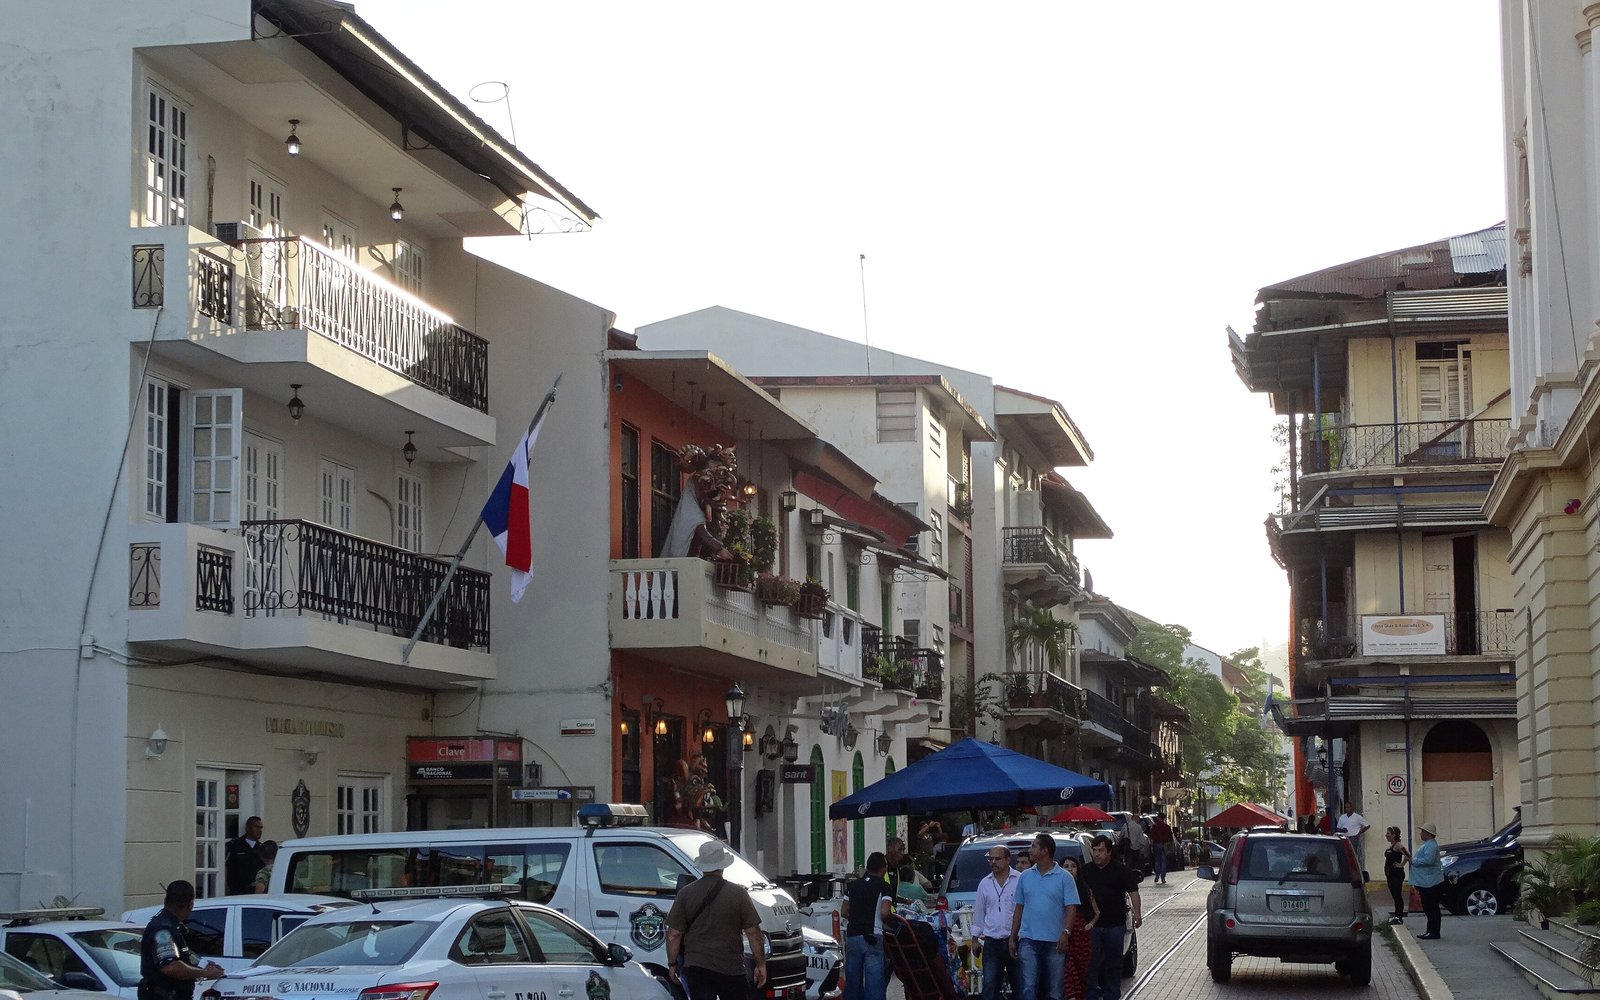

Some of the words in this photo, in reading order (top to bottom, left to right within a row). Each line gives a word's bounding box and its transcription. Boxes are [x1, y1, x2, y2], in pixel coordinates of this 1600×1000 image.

[438, 747, 465, 756] Clave
[784, 770, 807, 779] sant
[1283, 900, 1307, 909] 016401
[806, 956, 829, 970] LICIA
[242, 984, 271, 993] POLICIA
[293, 982, 336, 992] NACIONAL
